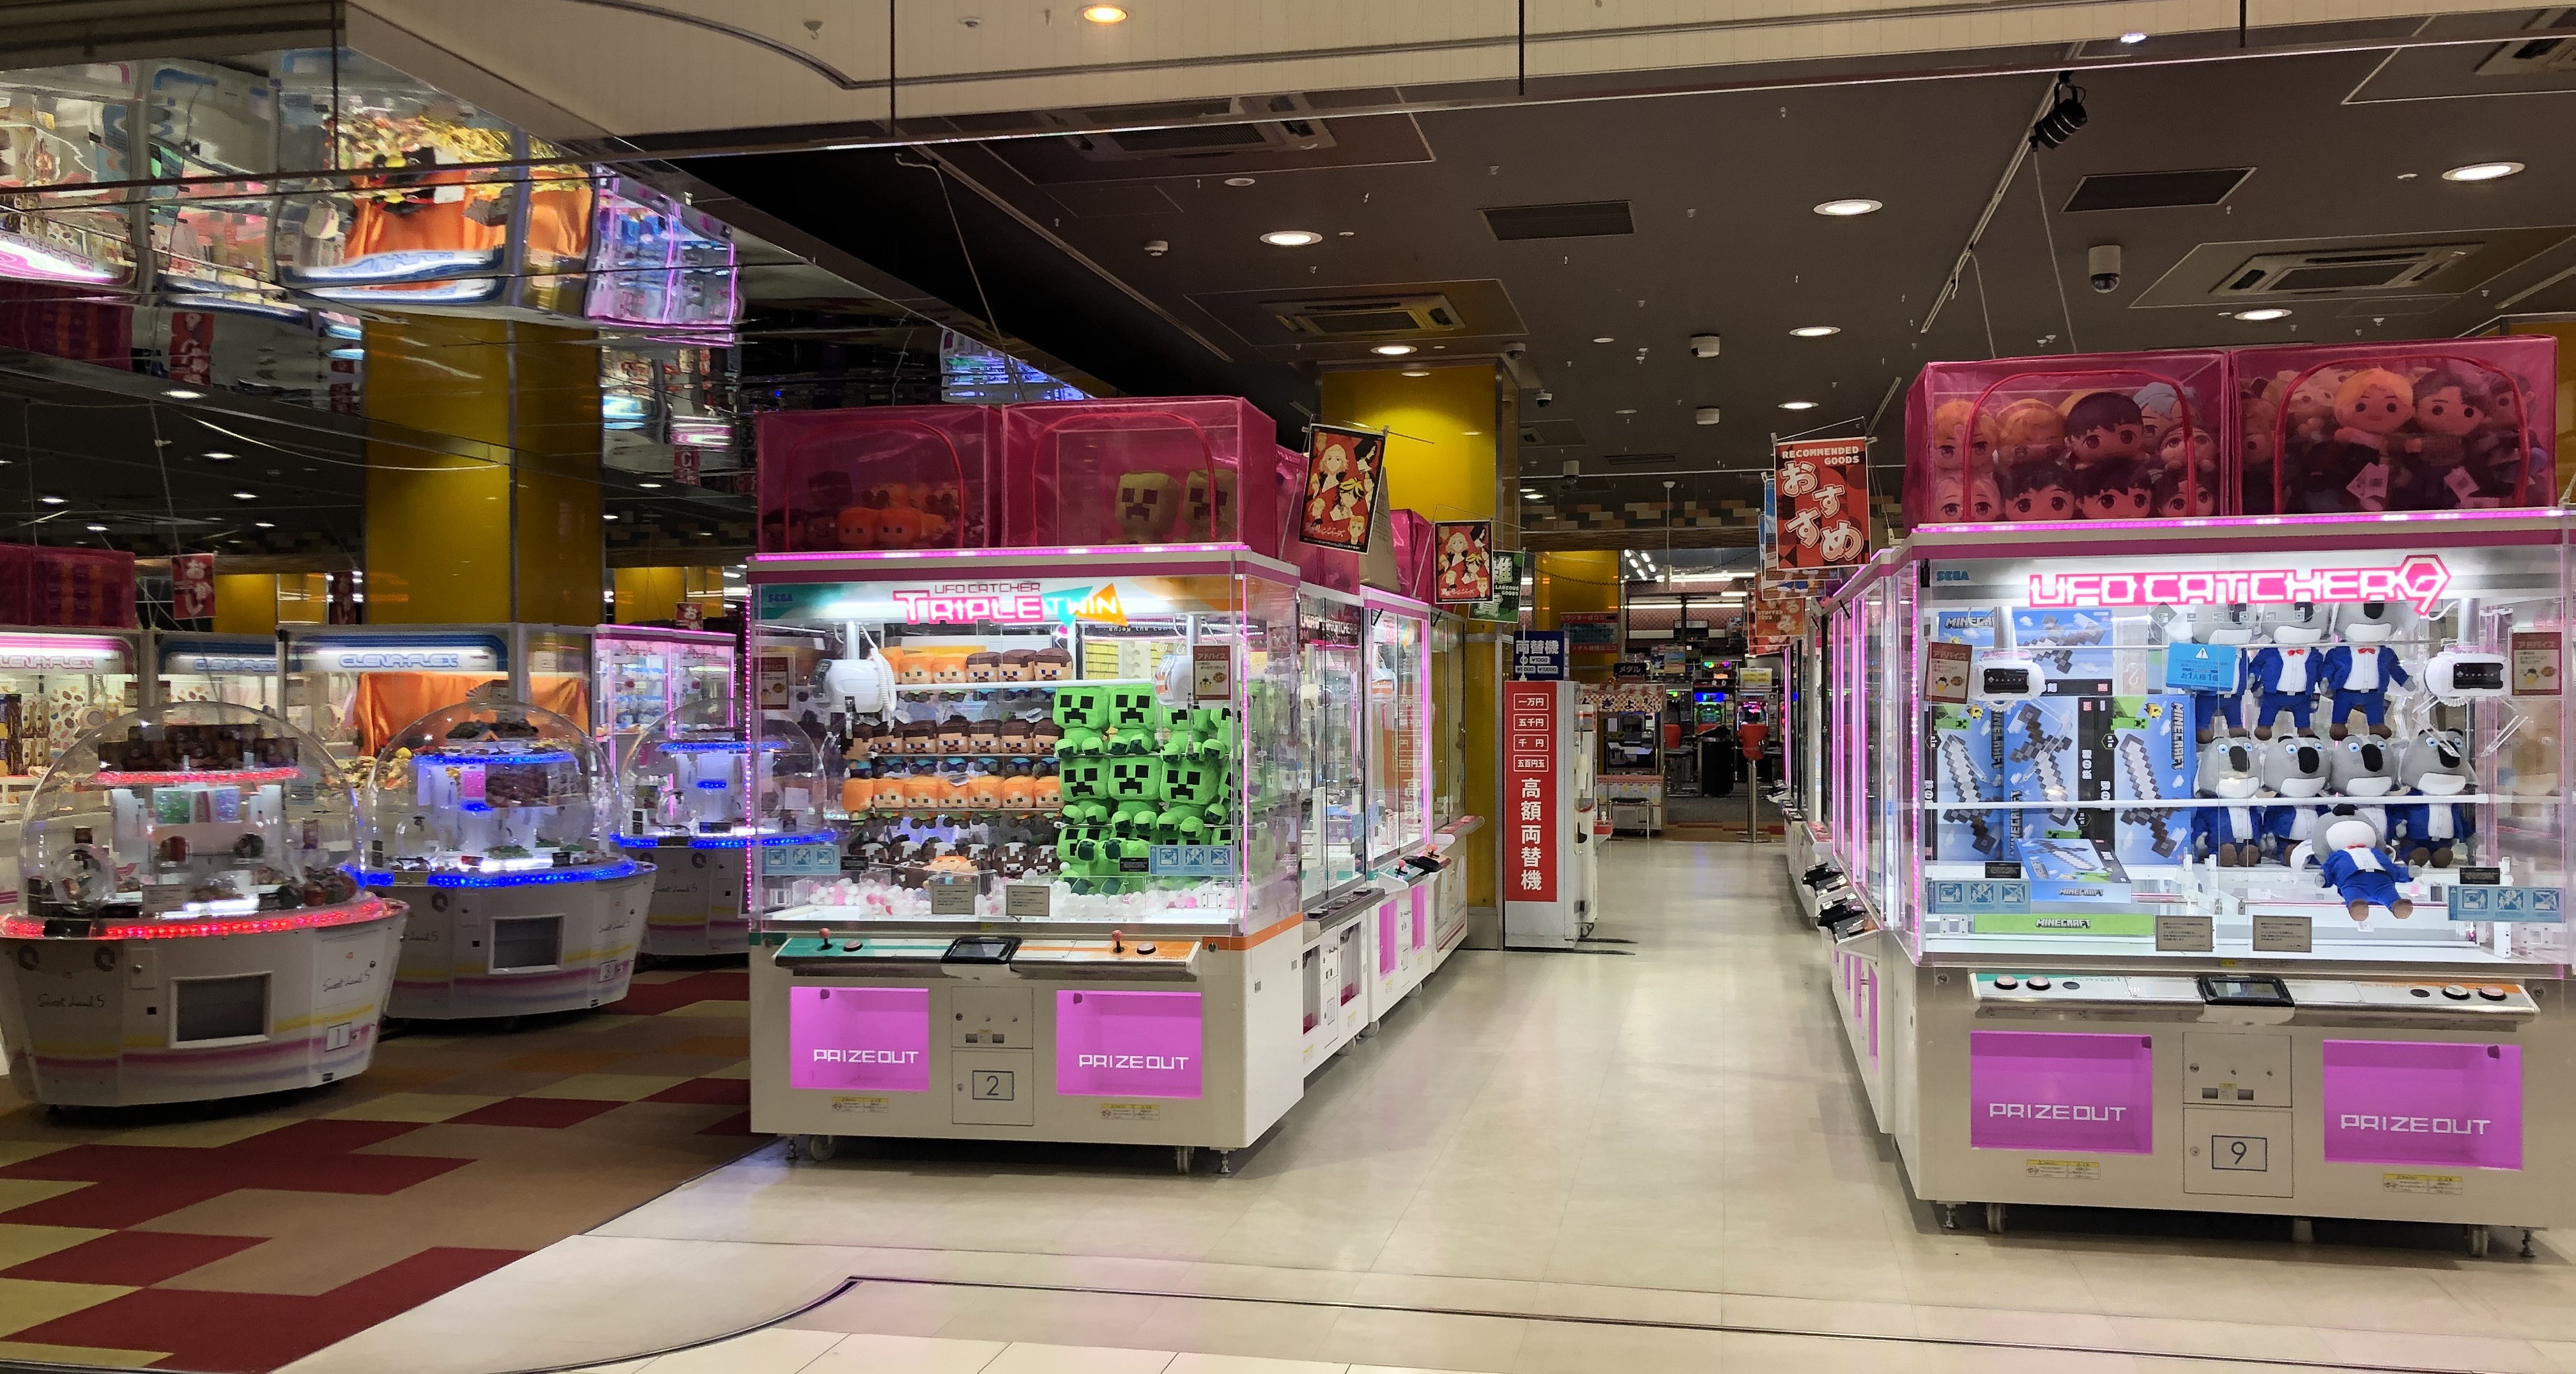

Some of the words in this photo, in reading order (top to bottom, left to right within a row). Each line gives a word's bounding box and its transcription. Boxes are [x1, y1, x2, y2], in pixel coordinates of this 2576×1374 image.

[1782, 446, 1859, 459] RECOMMENDED
[1824, 456, 1860, 465] GOODS
[1936, 570, 1970, 581] SEGA
[935, 583, 965, 594] UFO
[968, 582, 1041, 592] CATCHER
[2030, 574, 2135, 606] UFO
[2144, 570, 2397, 605] CATCHER
[768, 593, 793, 603] SEGA
[893, 589, 1046, 625] TRIPLE
[1945, 616, 1995, 629] MINECR
[1516, 640, 1560, 654] 両替機
[0, 654, 94, 670] LENA-FLEX
[1620, 665, 1642, 674] メダル
[1518, 697, 1544, 707] 一万円
[1518, 718, 1544, 727] 五千円
[2170, 702, 2184, 770] MINECRAFT
[1517, 759, 1545, 768] 五百円玉
[1521, 777, 1542, 891] 高額両替機
[2058, 887, 2104, 897] MINECRAFT
[2035, 917, 2092, 929] MINECRAFT
[96, 994, 105, 1008] 5
[986, 1075, 1000, 1096] 2
[2230, 1141, 2248, 1165] 9
